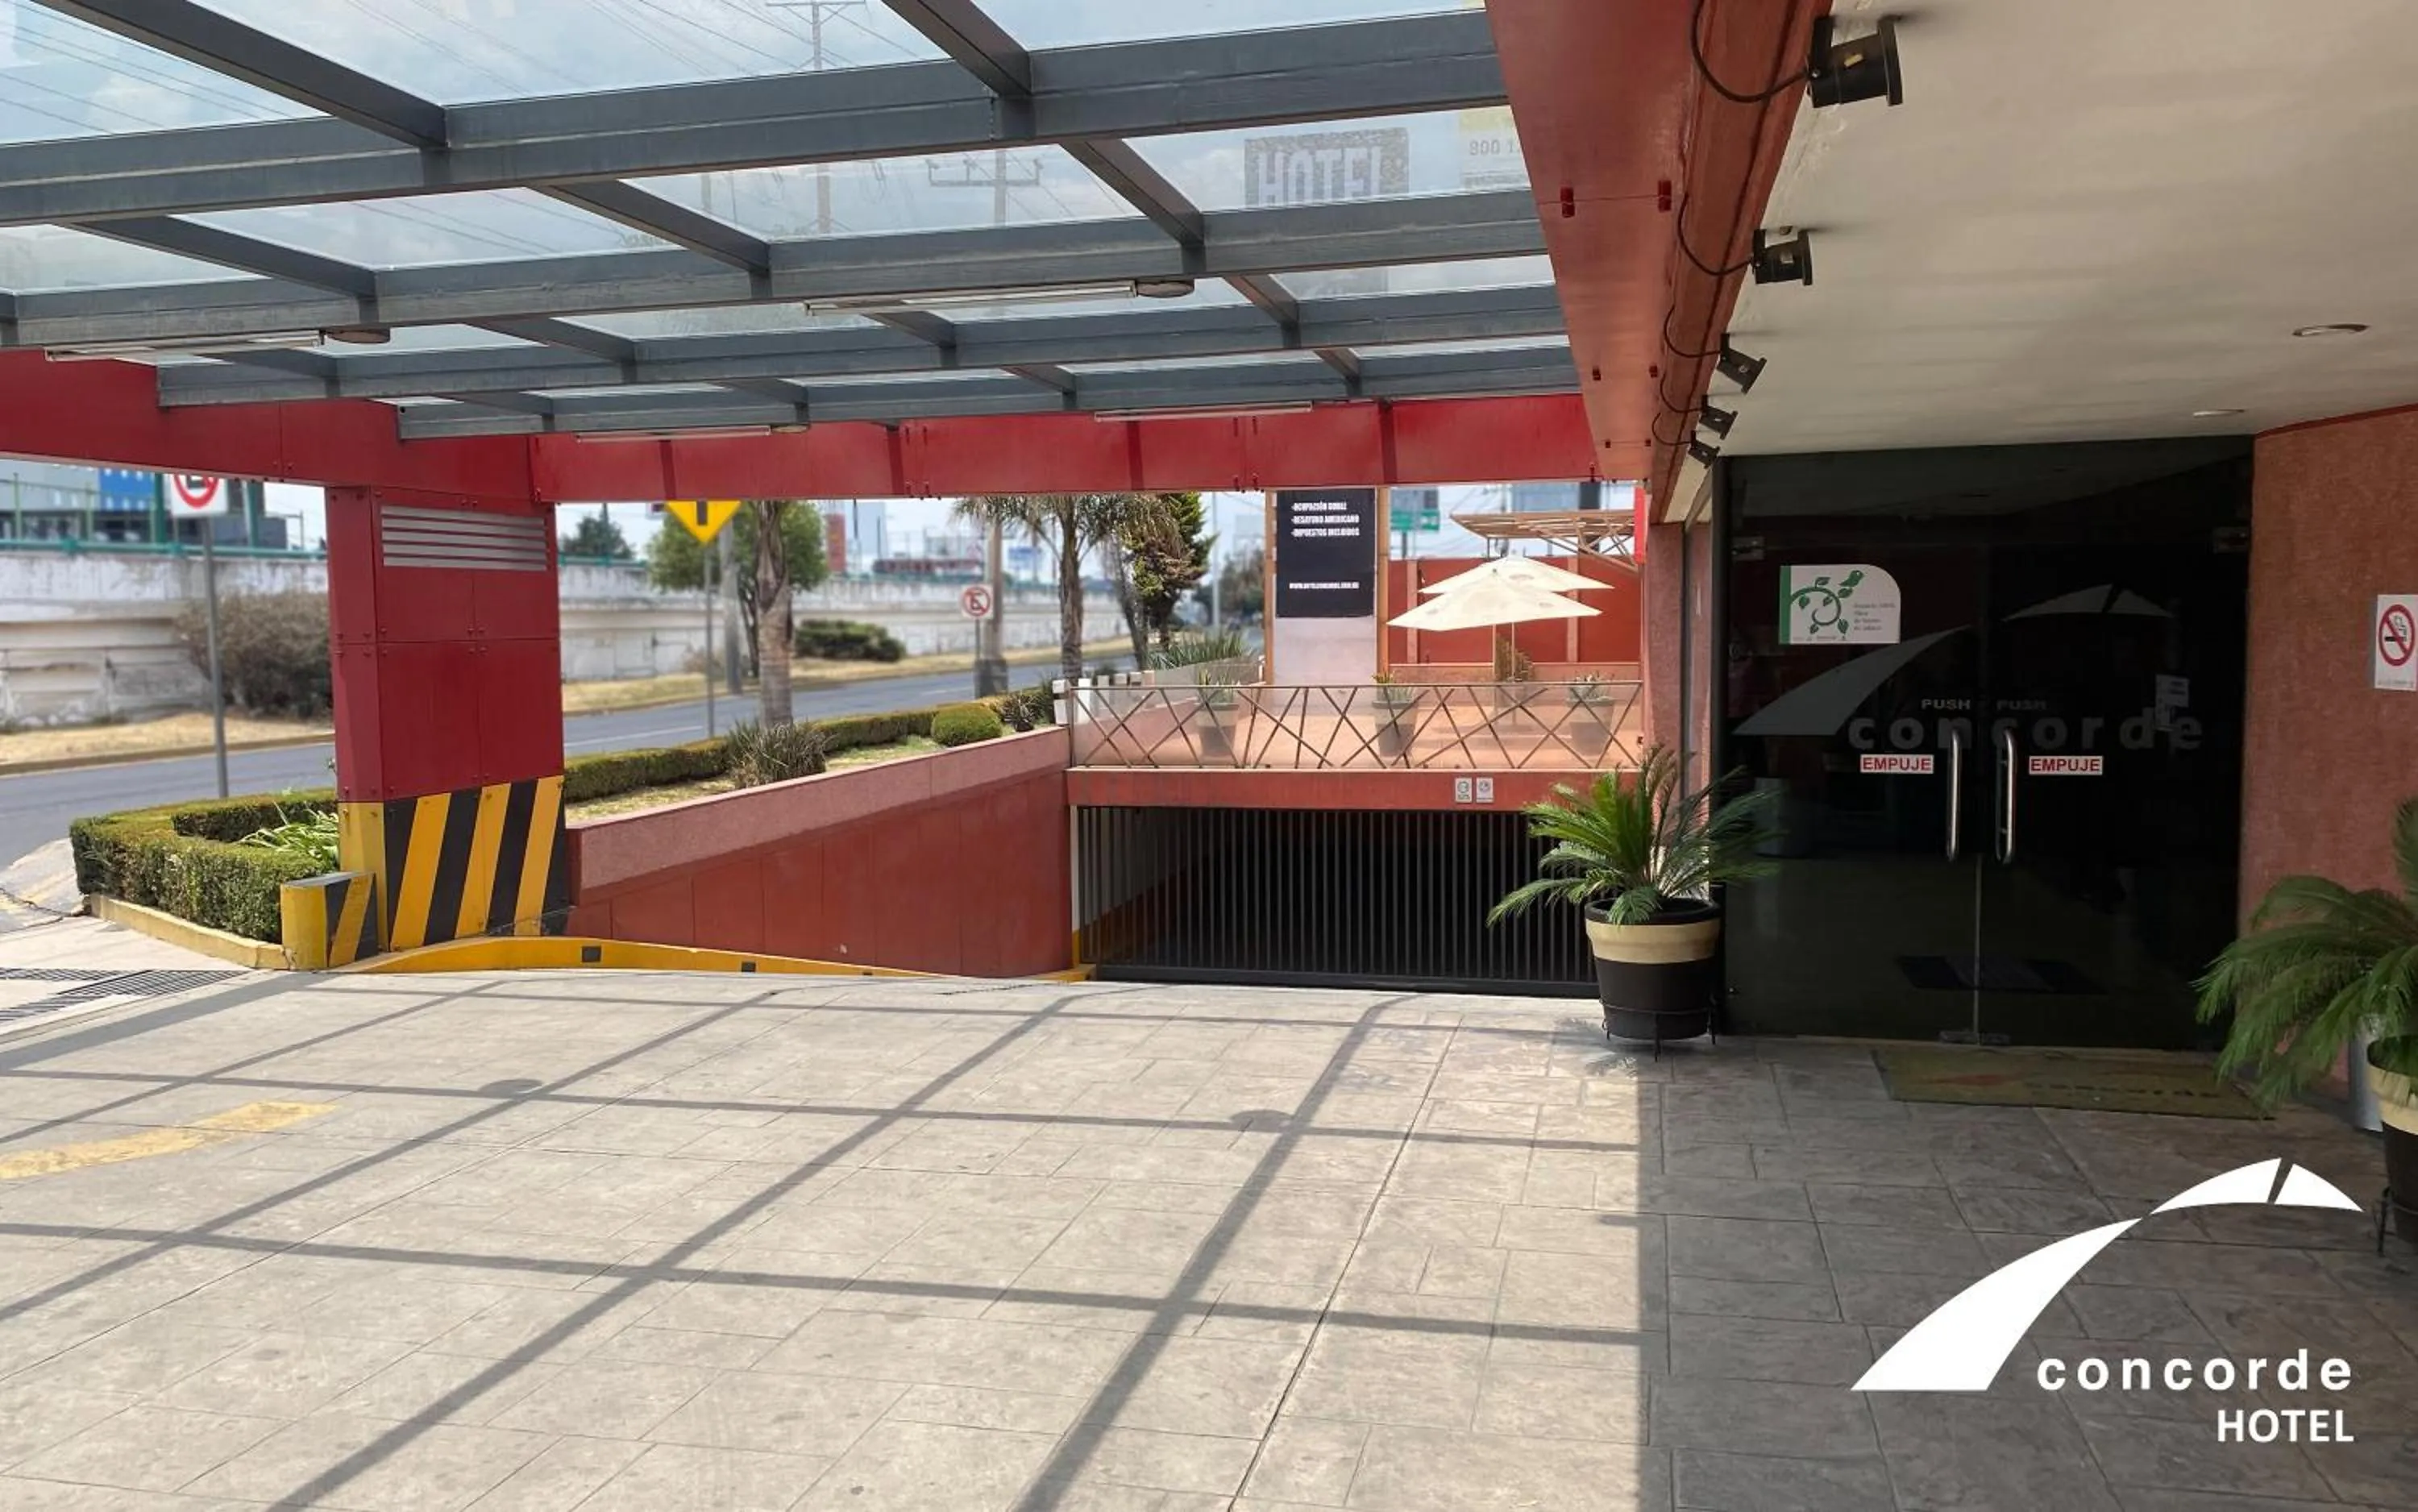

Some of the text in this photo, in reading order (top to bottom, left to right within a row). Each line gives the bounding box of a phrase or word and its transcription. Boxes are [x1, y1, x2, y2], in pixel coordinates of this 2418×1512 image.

[1922, 698, 1971, 711] PUSH
[1996, 699, 2047, 711] PUSH
[1848, 706, 2204, 751] concorde
[1862, 757, 1932, 772] EMPUJE
[2030, 758, 2101, 773] EMPUJE
